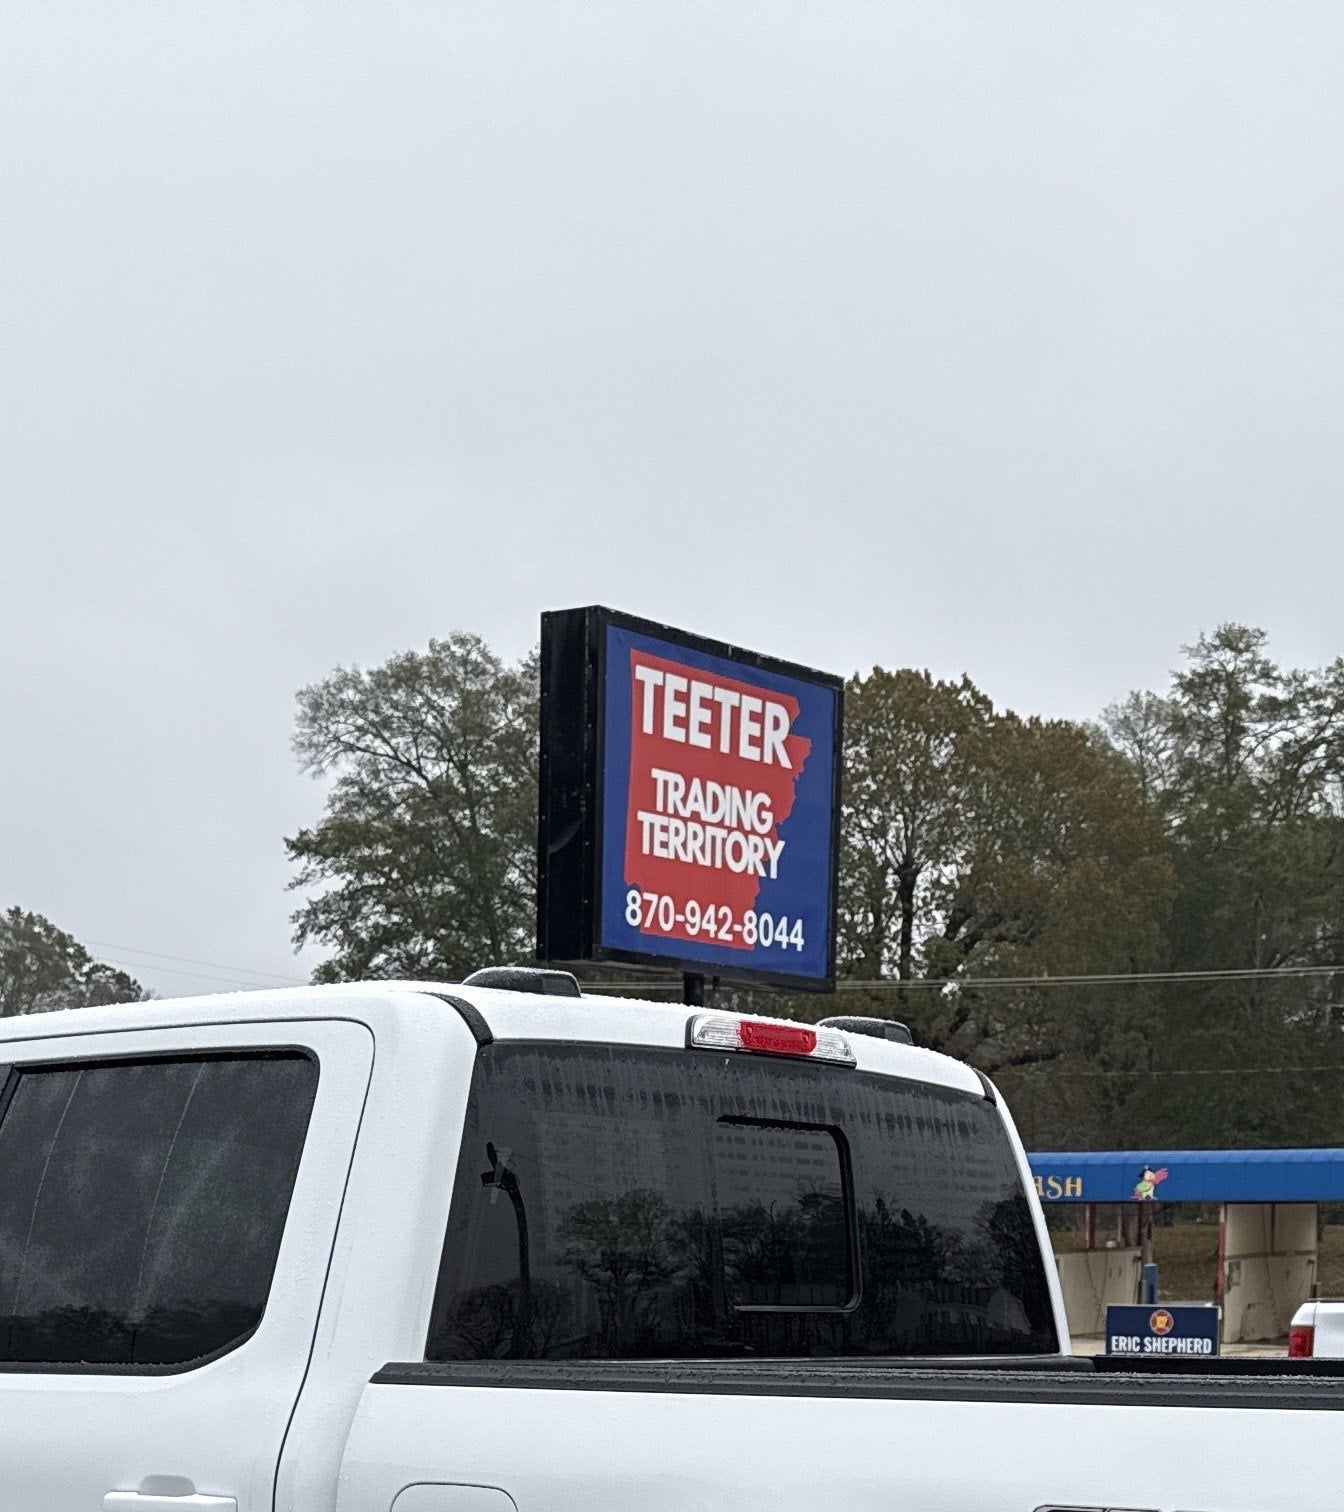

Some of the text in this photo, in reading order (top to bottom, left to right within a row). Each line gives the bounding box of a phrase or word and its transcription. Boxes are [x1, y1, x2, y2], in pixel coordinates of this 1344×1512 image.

[635, 665, 792, 769] TEETER
[651, 768, 774, 834] TRADING
[637, 811, 785, 879] TERRITORY
[625, 889, 804, 952] 870-942-8044
[1111, 1336, 1212, 1354] ERIC SHEPHERD
